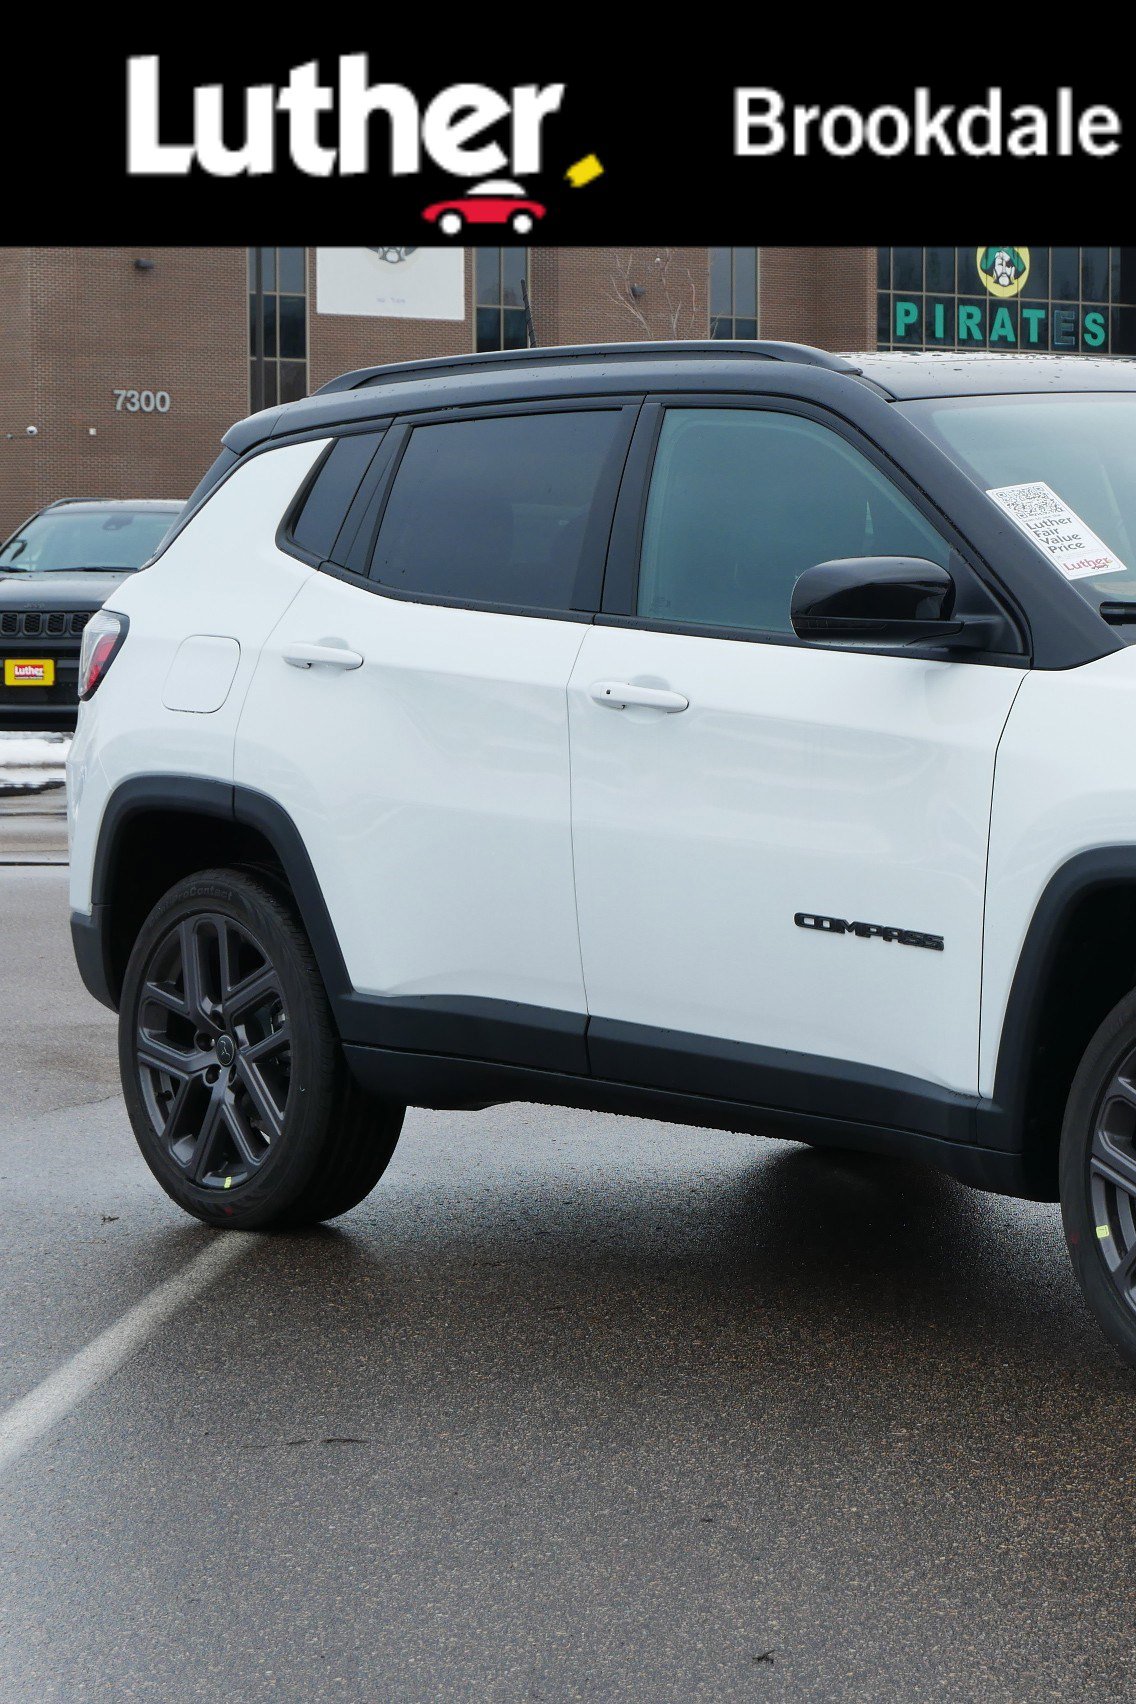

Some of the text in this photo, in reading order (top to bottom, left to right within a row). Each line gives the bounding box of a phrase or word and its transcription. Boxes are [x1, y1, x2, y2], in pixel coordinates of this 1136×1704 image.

[895, 301, 1106, 347] PIRATES
[113, 389, 171, 413] 7300
[1025, 516, 1073, 531] Luther
[1032, 527, 1060, 538] Fair
[1039, 533, 1082, 546] Value
[1048, 541, 1086, 554] Price
[1062, 556, 1109, 572] Luther
[15, 665, 44, 676] Luther
[793, 911, 945, 952] COMPASS
